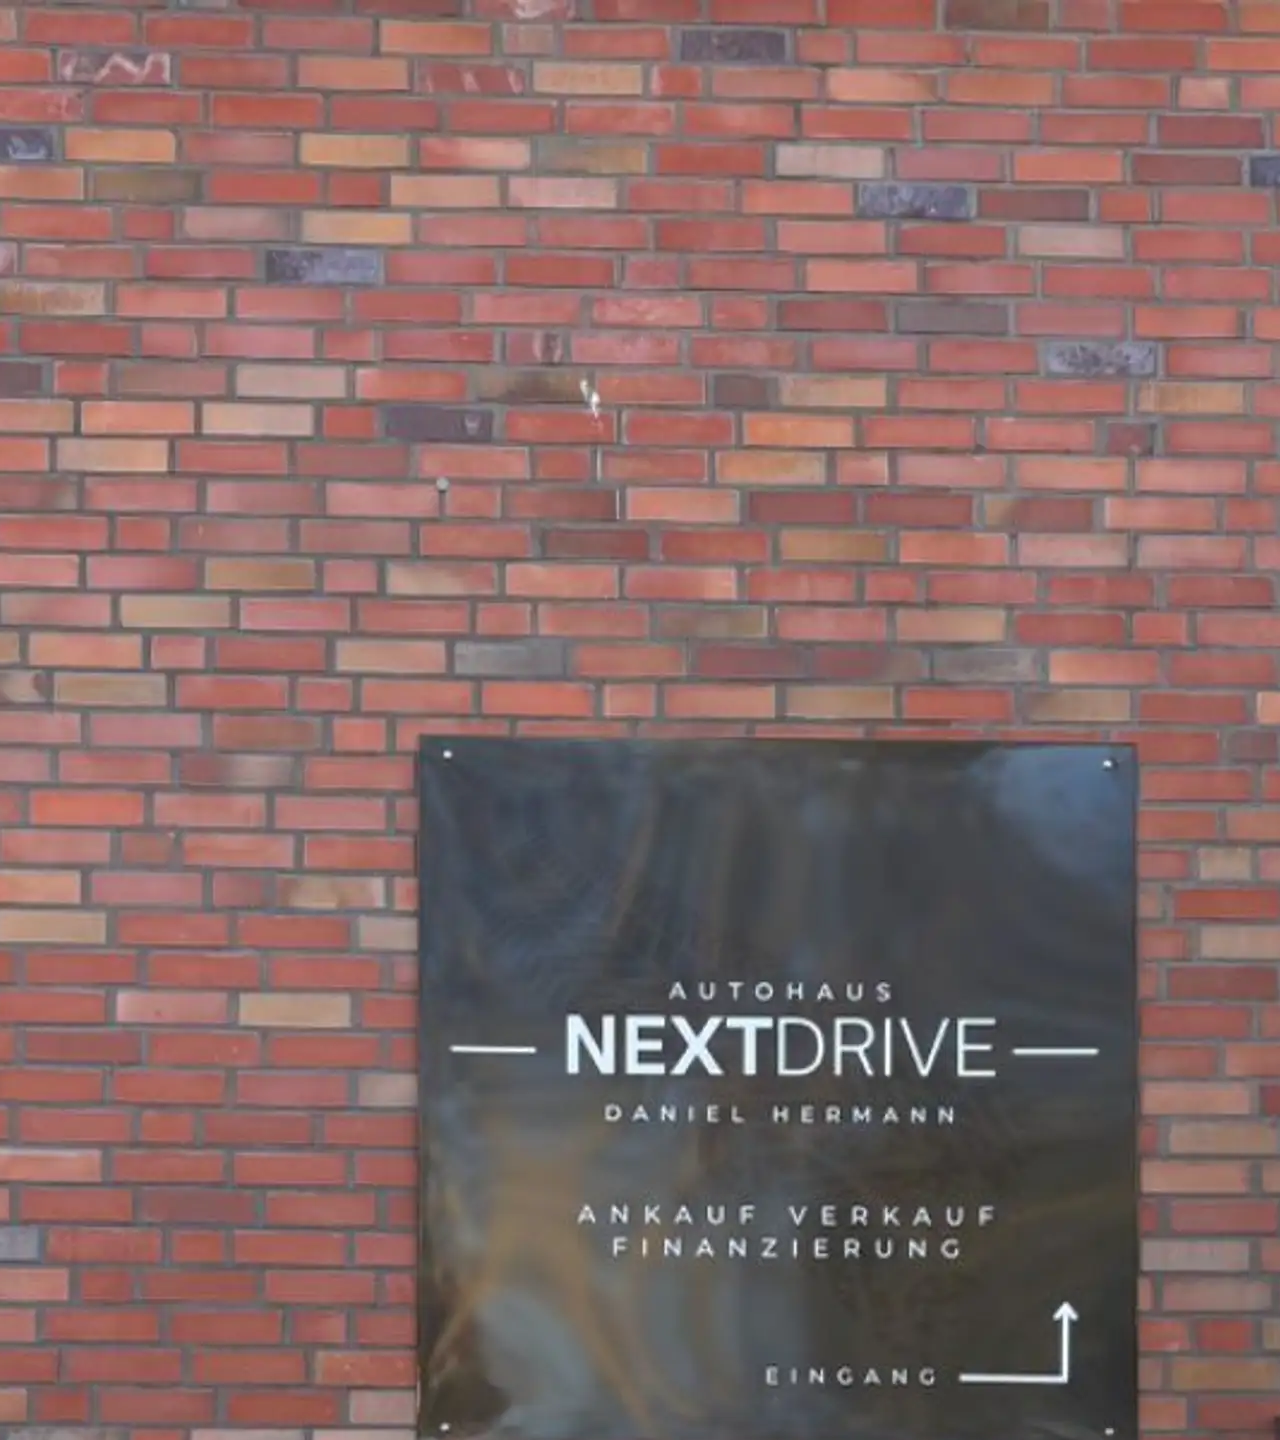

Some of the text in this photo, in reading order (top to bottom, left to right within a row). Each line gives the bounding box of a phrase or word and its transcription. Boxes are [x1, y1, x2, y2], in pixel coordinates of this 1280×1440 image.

[669, 981, 891, 1003] AUTOHAUS
[565, 1013, 997, 1079] NEXTDRIVE
[604, 1104, 955, 1125] DANIEL HERMANN
[577, 1204, 995, 1227] ANKAUF VERKAUF
[611, 1236, 961, 1260] FINANZIERUNG
[765, 1366, 936, 1387] EINGANG
